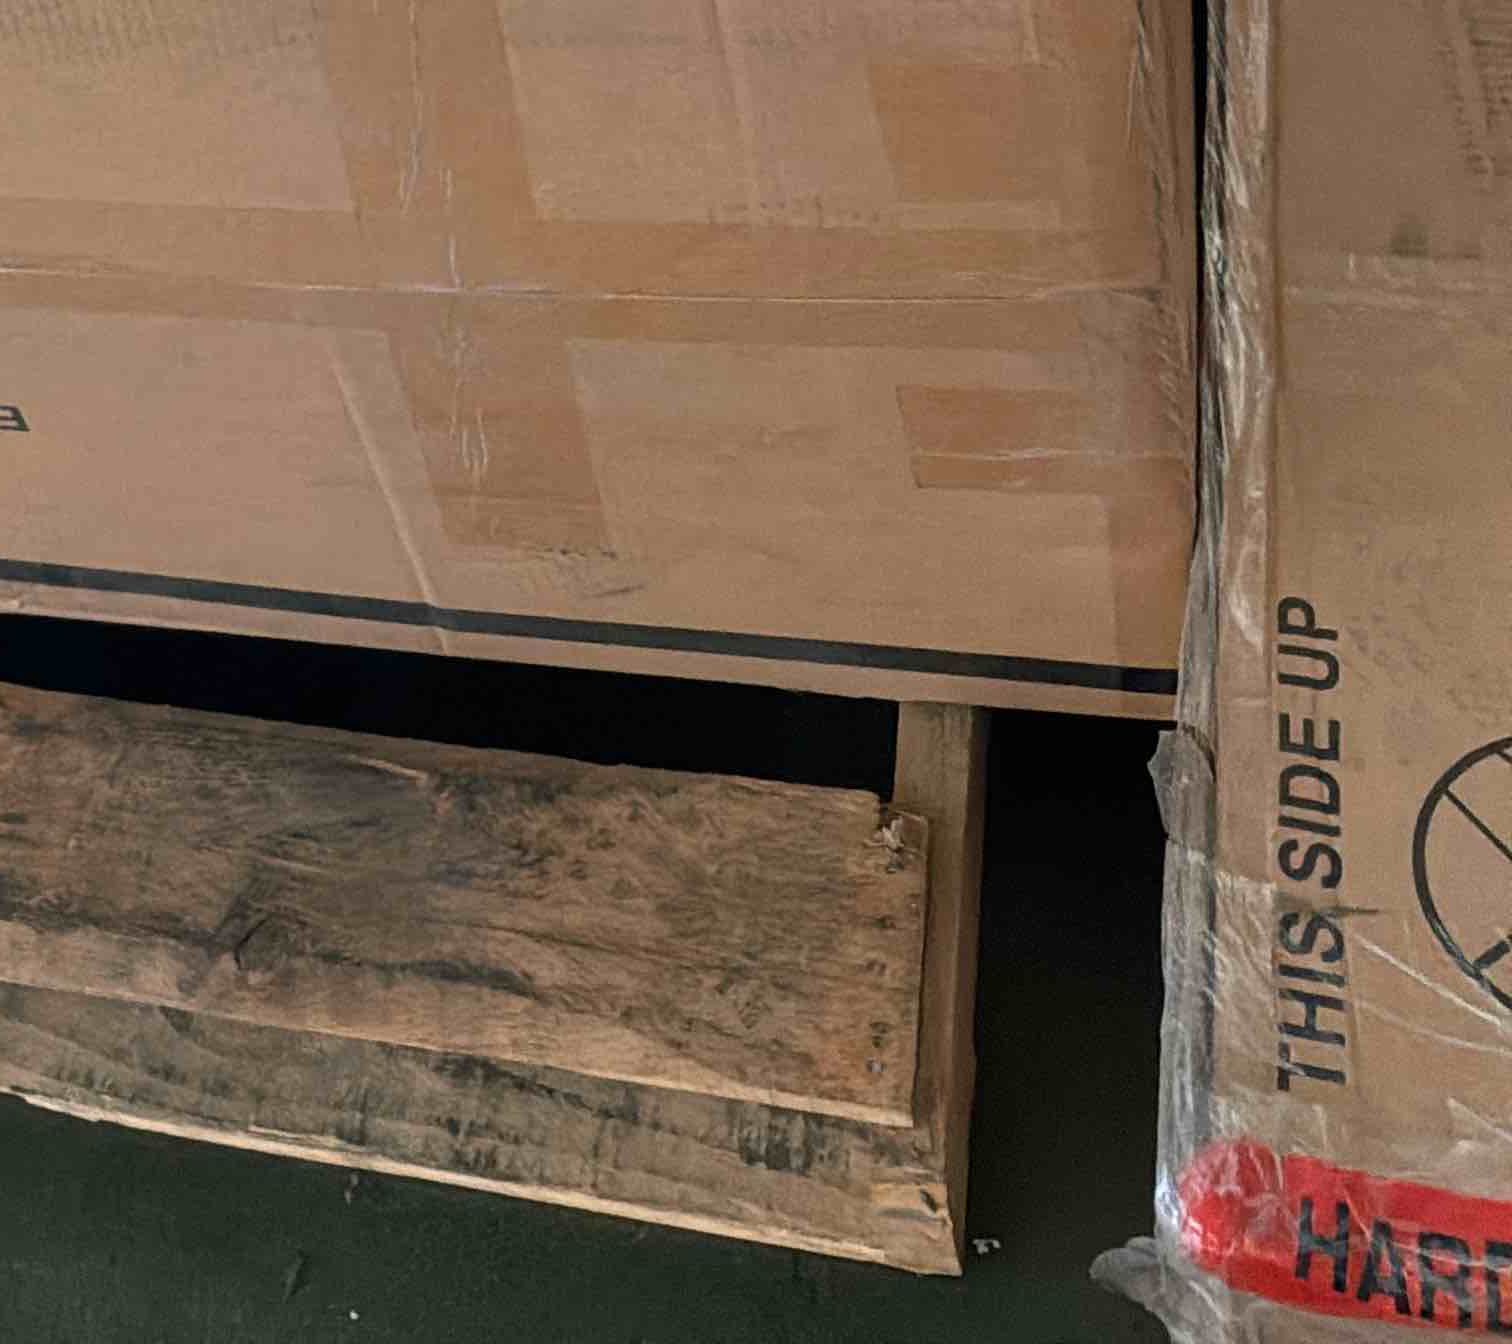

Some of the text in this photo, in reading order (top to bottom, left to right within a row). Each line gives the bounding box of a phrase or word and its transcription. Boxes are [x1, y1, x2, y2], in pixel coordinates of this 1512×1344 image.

[1277, 594, 1348, 1093] THIS SIDE UP
